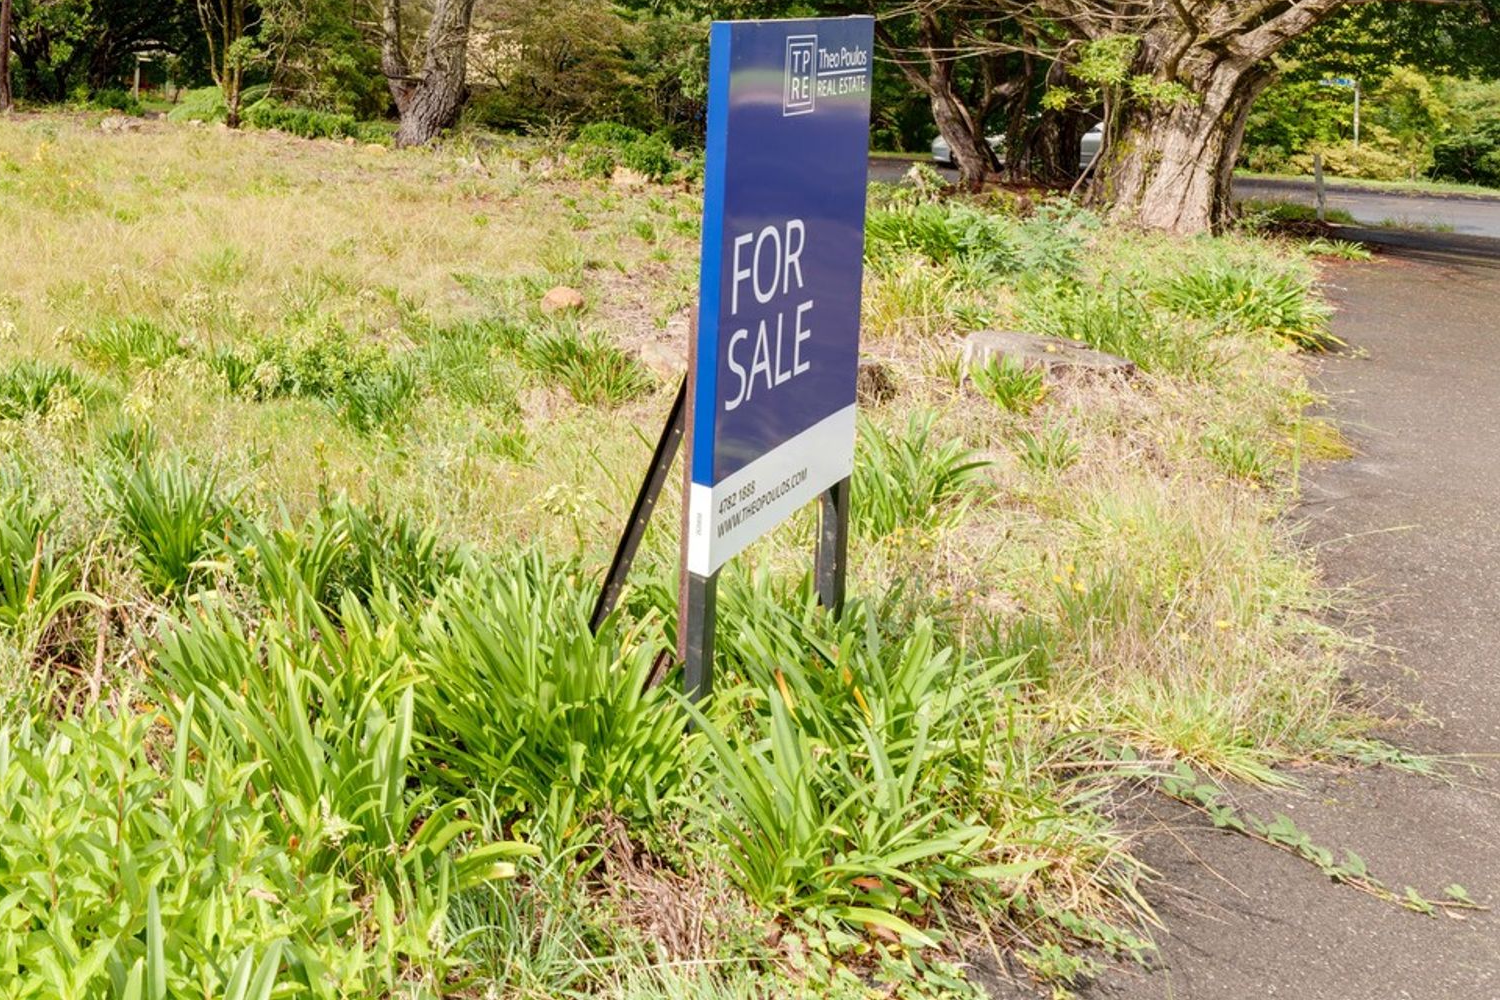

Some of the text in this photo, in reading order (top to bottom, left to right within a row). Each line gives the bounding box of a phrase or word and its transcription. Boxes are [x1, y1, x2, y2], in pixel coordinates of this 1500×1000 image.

[817, 74, 866, 97] REAL ESTATE
[819, 45, 867, 69] Theo Poulos
[731, 218, 805, 315] FOR
[725, 300, 813, 411] SALE
